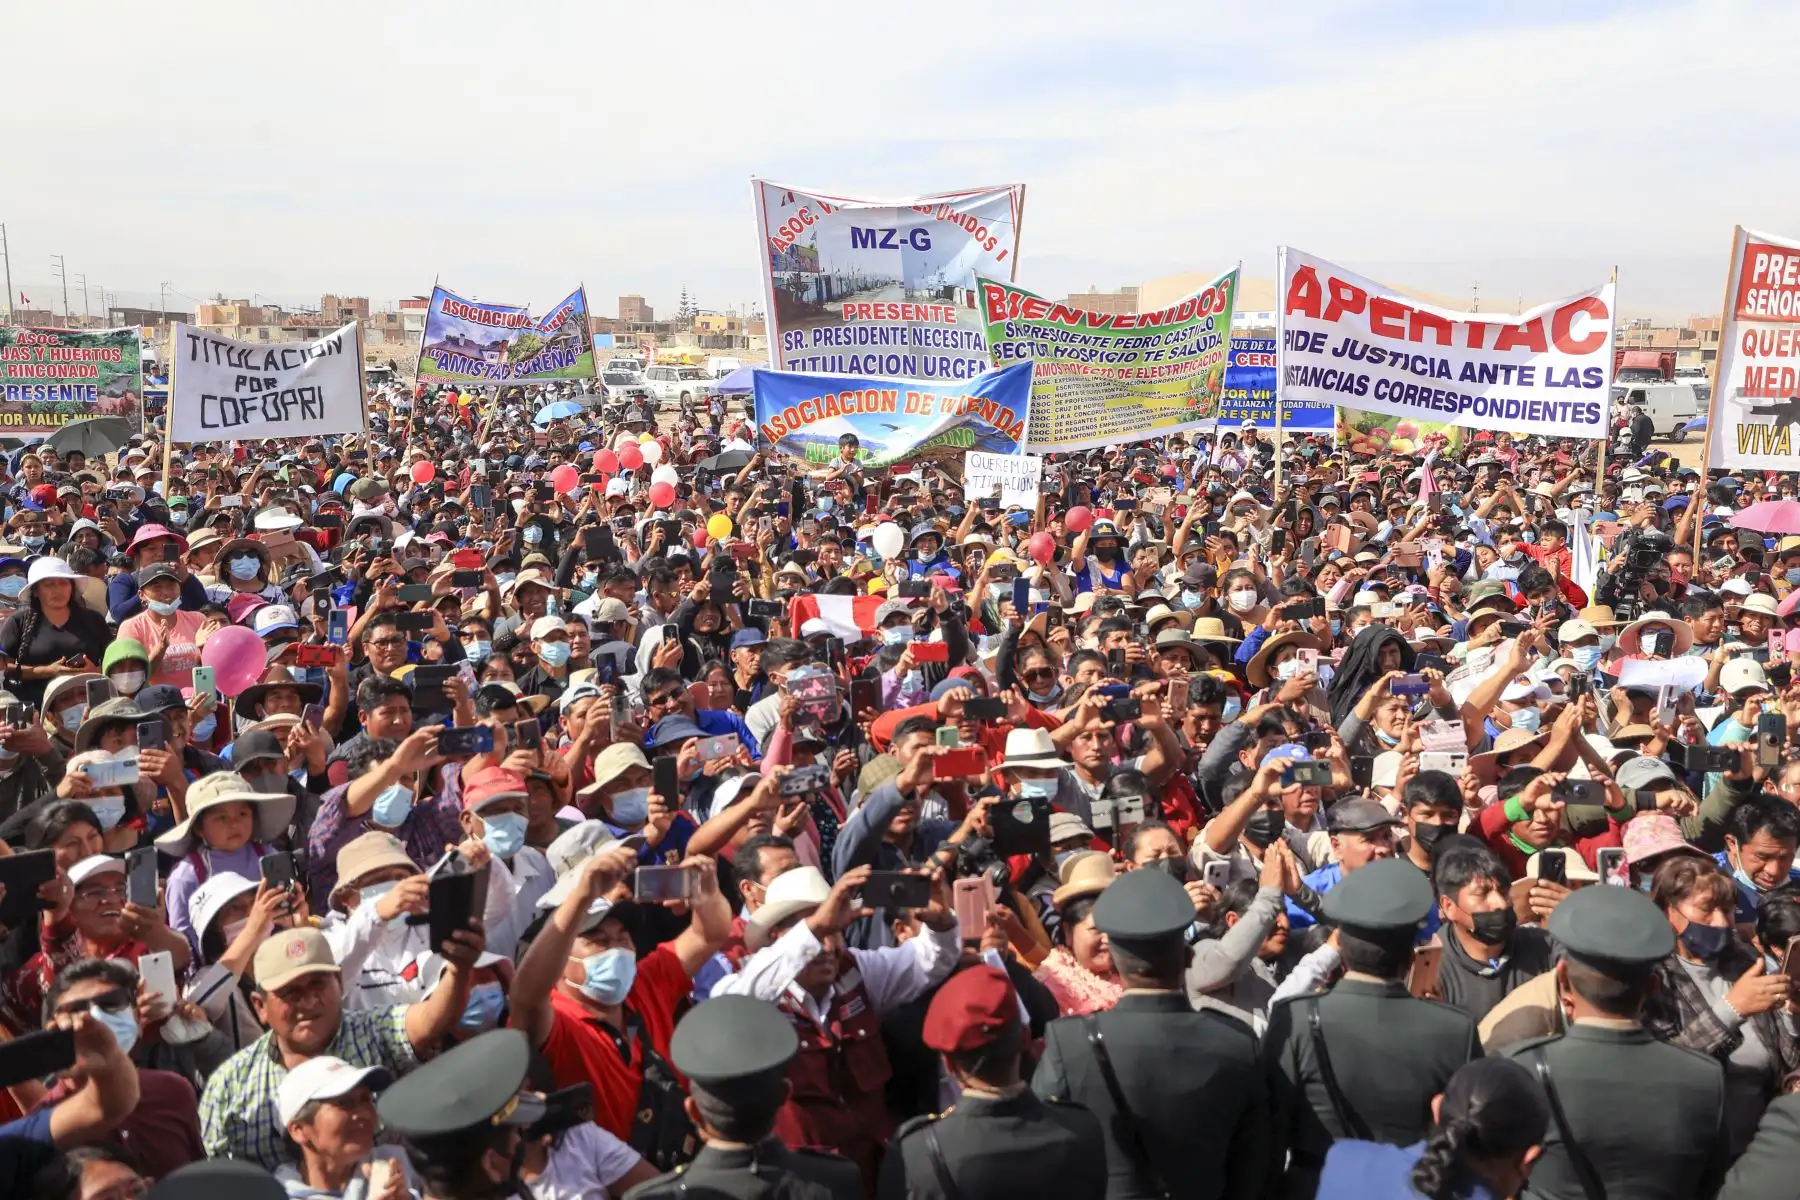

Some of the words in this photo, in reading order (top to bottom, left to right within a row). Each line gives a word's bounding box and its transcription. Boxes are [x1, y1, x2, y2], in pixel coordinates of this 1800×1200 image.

[771, 207, 820, 254] ASOC.
[850, 226, 932, 252] MZ-G
[936, 203, 998, 252] UNIDOS
[1752, 253, 1800, 286] PRE
[441, 298, 524, 329] ASOCIACION
[842, 303, 957, 324] PRESENTE
[982, 278, 1232, 331] BIENVENIDOS
[16, 332, 65, 345] ASOC.
[783, 329, 809, 352] SR.
[812, 326, 909, 347] PRESIDENTE
[1053, 346, 1139, 363] HOSPICIO
[1144, 349, 1166, 363] TE
[1167, 332, 1223, 360] SALUDA
[1113, 334, 1162, 349] PEDRO
[1249, 340, 1265, 351] DE
[1, 346, 31, 361] JAS
[35, 346, 46, 361] Y
[49, 347, 122, 363] HUERTOS
[187, 333, 343, 372] TITULACION
[787, 354, 917, 377] TITULACION
[1117, 367, 1134, 380] DE
[1135, 349, 1224, 379] ELECTRIFICACION
[1285, 330, 1329, 354] PIDE
[1332, 337, 1453, 380] JUSTICIA
[1459, 361, 1536, 387] ANTE
[1545, 366, 1604, 389] LAS
[7, 363, 99, 379] RINCONADA
[235, 375, 279, 393] POR
[1055, 391, 1080, 399] HUERTA
[1221, 400, 1231, 408] LA
[1232, 400, 1266, 408] ALIANZA
[1267, 400, 1274, 408] Y
[1304, 401, 1331, 409] NUEVA
[1285, 364, 1370, 397] INSTANCIAS
[1373, 378, 1601, 425] CORRESPONDIENTES
[200, 386, 325, 430] COFOPRI
[759, 388, 899, 445] ASOCIACION
[904, 390, 937, 417] DE
[1065, 417, 1098, 426] REGANTES
[1070, 431, 1097, 440] ANTONIO
[1737, 423, 1792, 456] VIVA
[970, 453, 1037, 475] QUEREMOS
